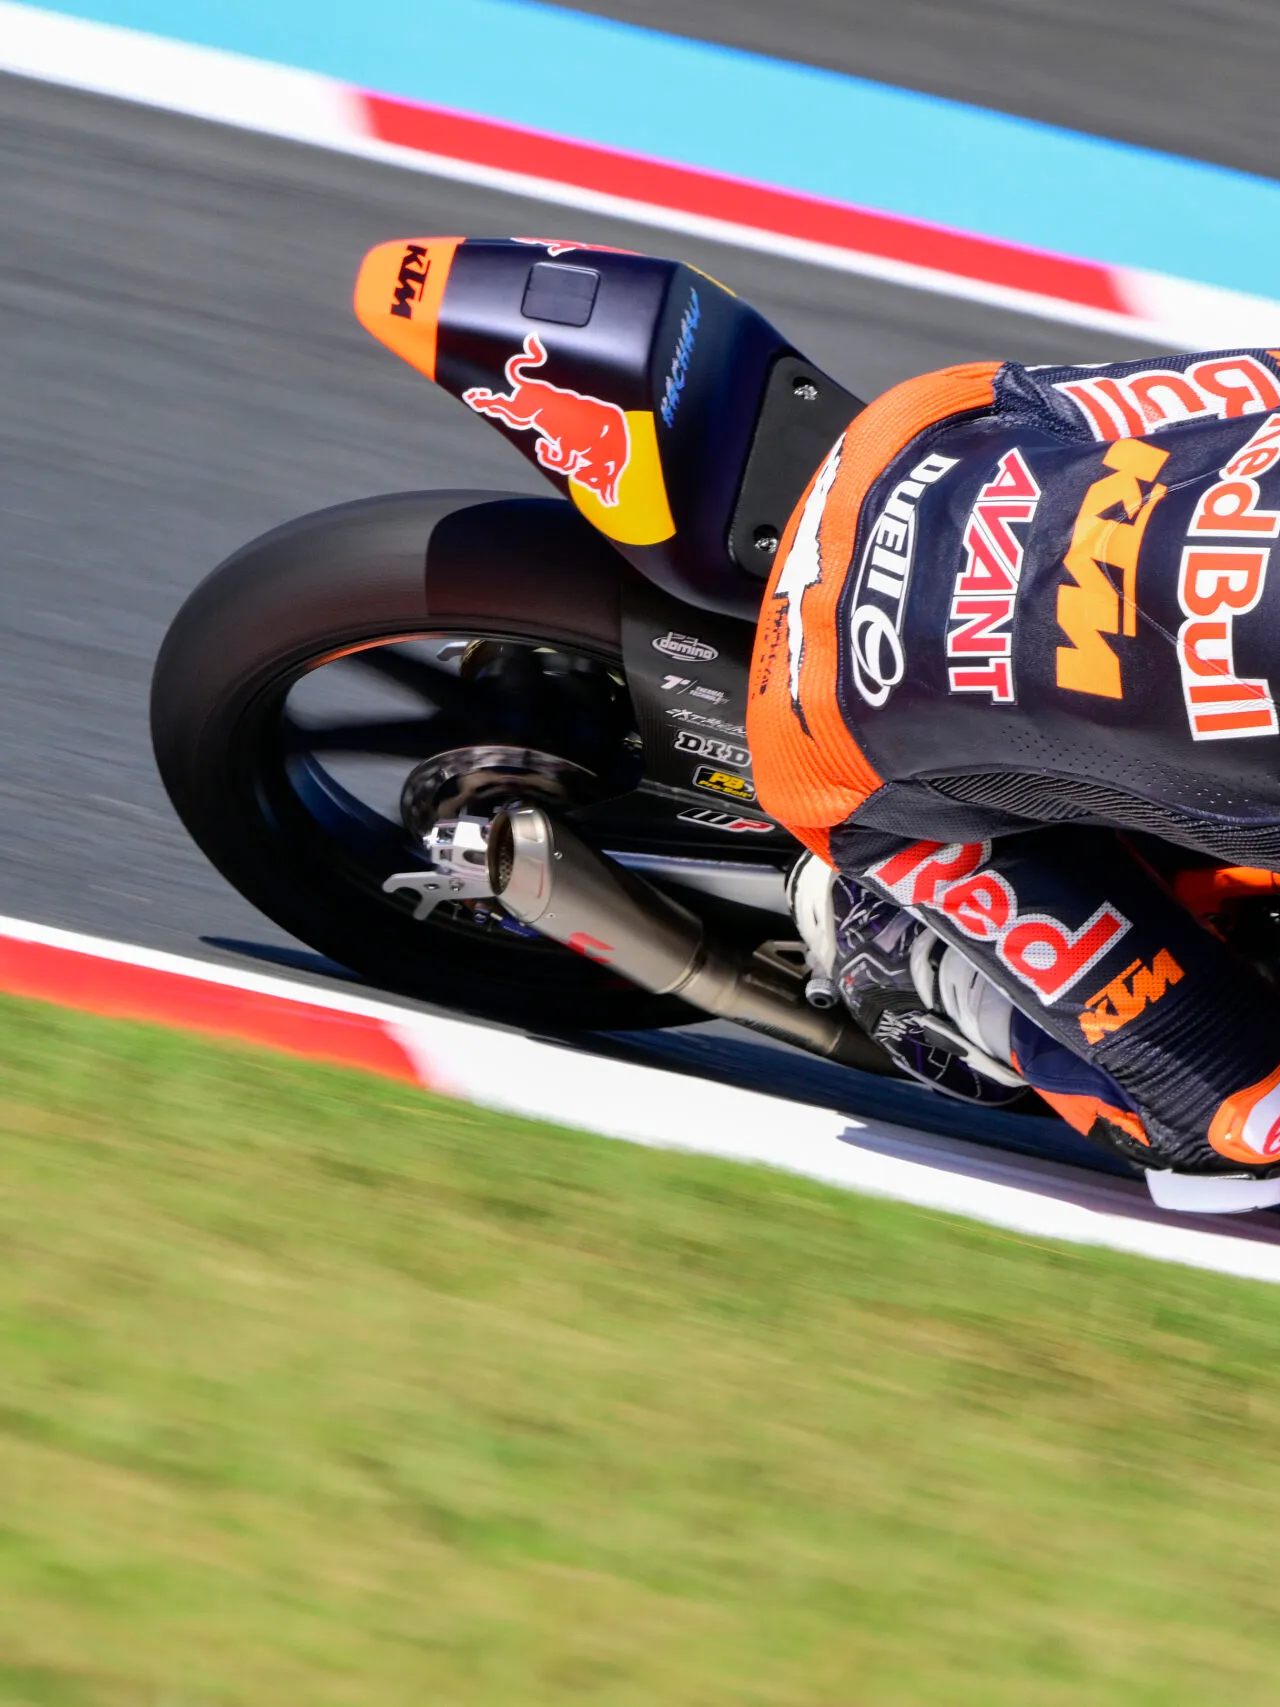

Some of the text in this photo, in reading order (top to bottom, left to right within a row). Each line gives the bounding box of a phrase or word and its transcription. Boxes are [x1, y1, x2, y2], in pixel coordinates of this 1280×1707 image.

[391, 245, 431, 319] KTM
[948, 447, 1041, 706] AVANT
[1056, 438, 1171, 699] KTM
[660, 632, 712, 660] domino
[1176, 545, 1280, 742] Bull
[710, 771, 746, 790] PB
[863, 840, 1134, 1006] Red
[1078, 948, 1186, 1045] KTM
